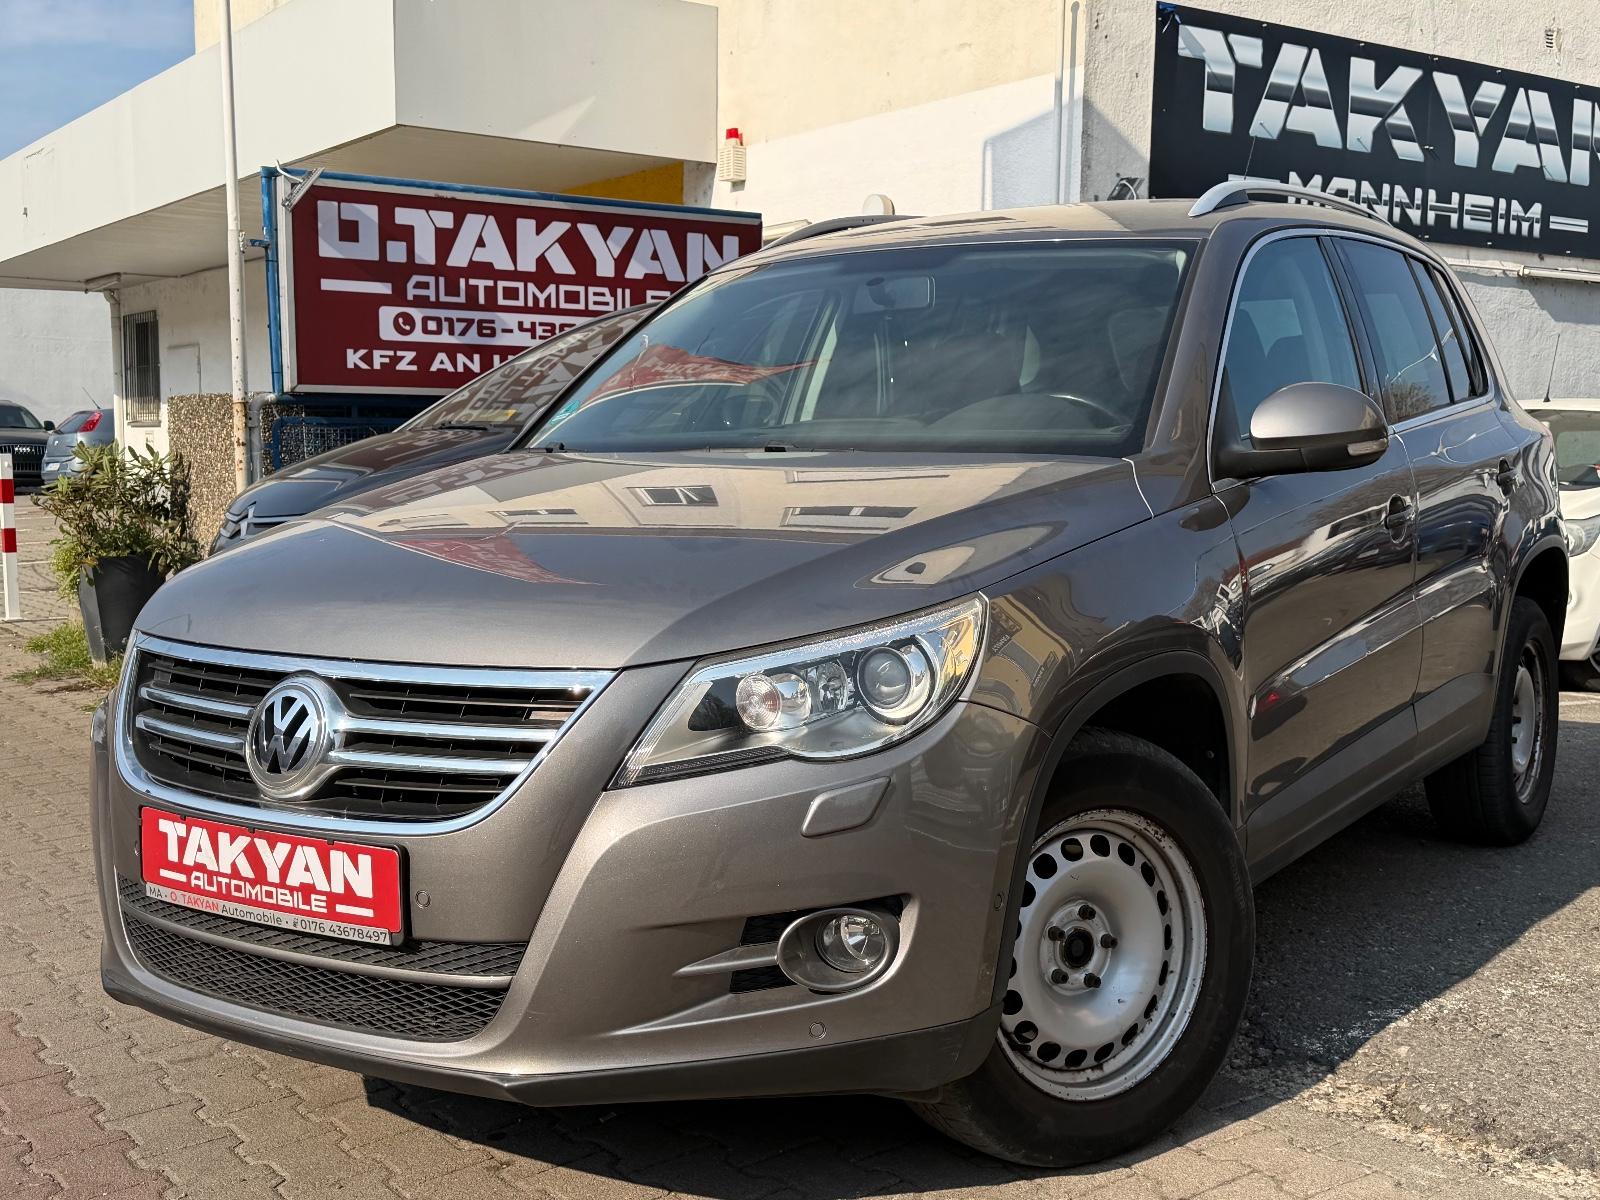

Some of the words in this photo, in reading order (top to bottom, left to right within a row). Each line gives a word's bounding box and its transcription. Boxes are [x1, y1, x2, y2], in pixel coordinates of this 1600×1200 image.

[346, 348, 418, 371] KFZ
[429, 351, 480, 373] AN
[158, 818, 373, 898] TAKYAN
[190, 870, 328, 913] AUTOMOBILE
[182, 894, 219, 912] TAKYAN
[221, 904, 282, 925] Automobile
[300, 919, 326, 933] 0176
[328, 926, 388, 943] 43678497
